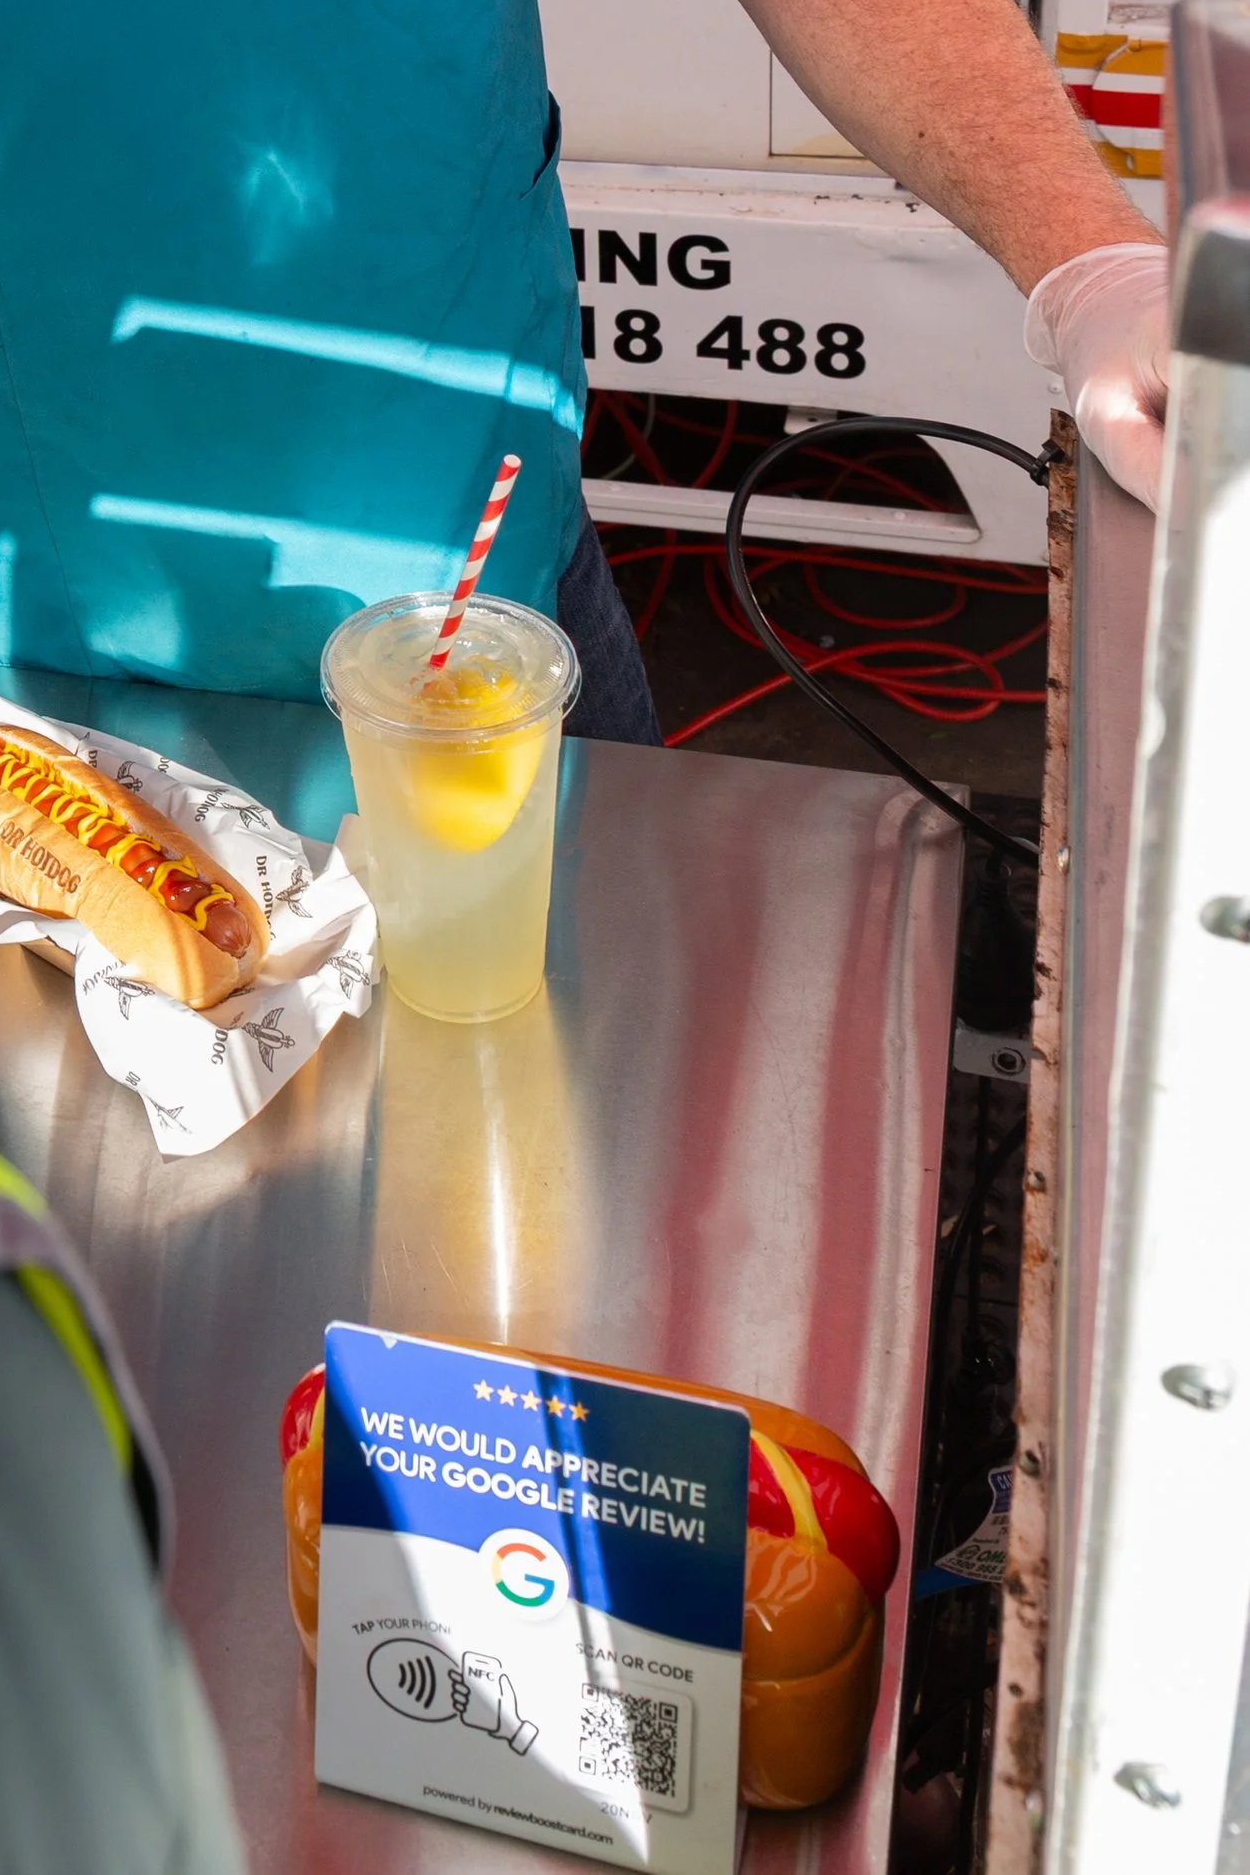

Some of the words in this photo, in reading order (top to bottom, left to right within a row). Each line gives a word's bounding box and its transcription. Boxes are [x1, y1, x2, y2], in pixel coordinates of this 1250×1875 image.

[696, 315, 866, 379] 488
[0, 821, 24, 850] DR
[20, 837, 81, 894] HOTDOG
[256, 855, 268, 877] DR
[361, 1406, 405, 1440] WE
[409, 1418, 516, 1464] WOULD
[522, 1445, 707, 1509] APPRECIATE
[360, 1441, 437, 1483] YOUR
[442, 1461, 575, 1515] GOOGLE
[581, 1492, 706, 1543] REVIEW!
[352, 1620, 375, 1636] TAP
[376, 1618, 411, 1631] YOUR
[411, 1619, 452, 1635] PHON
[468, 1666, 495, 1683] NFC
[575, 1642, 618, 1665] SCAN
[621, 1653, 645, 1672] QR
[647, 1661, 694, 1684] CODE
[422, 1784, 476, 1808] powered
[478, 1798, 492, 1814] by
[493, 1805, 614, 1845] reviewboostcard.com
